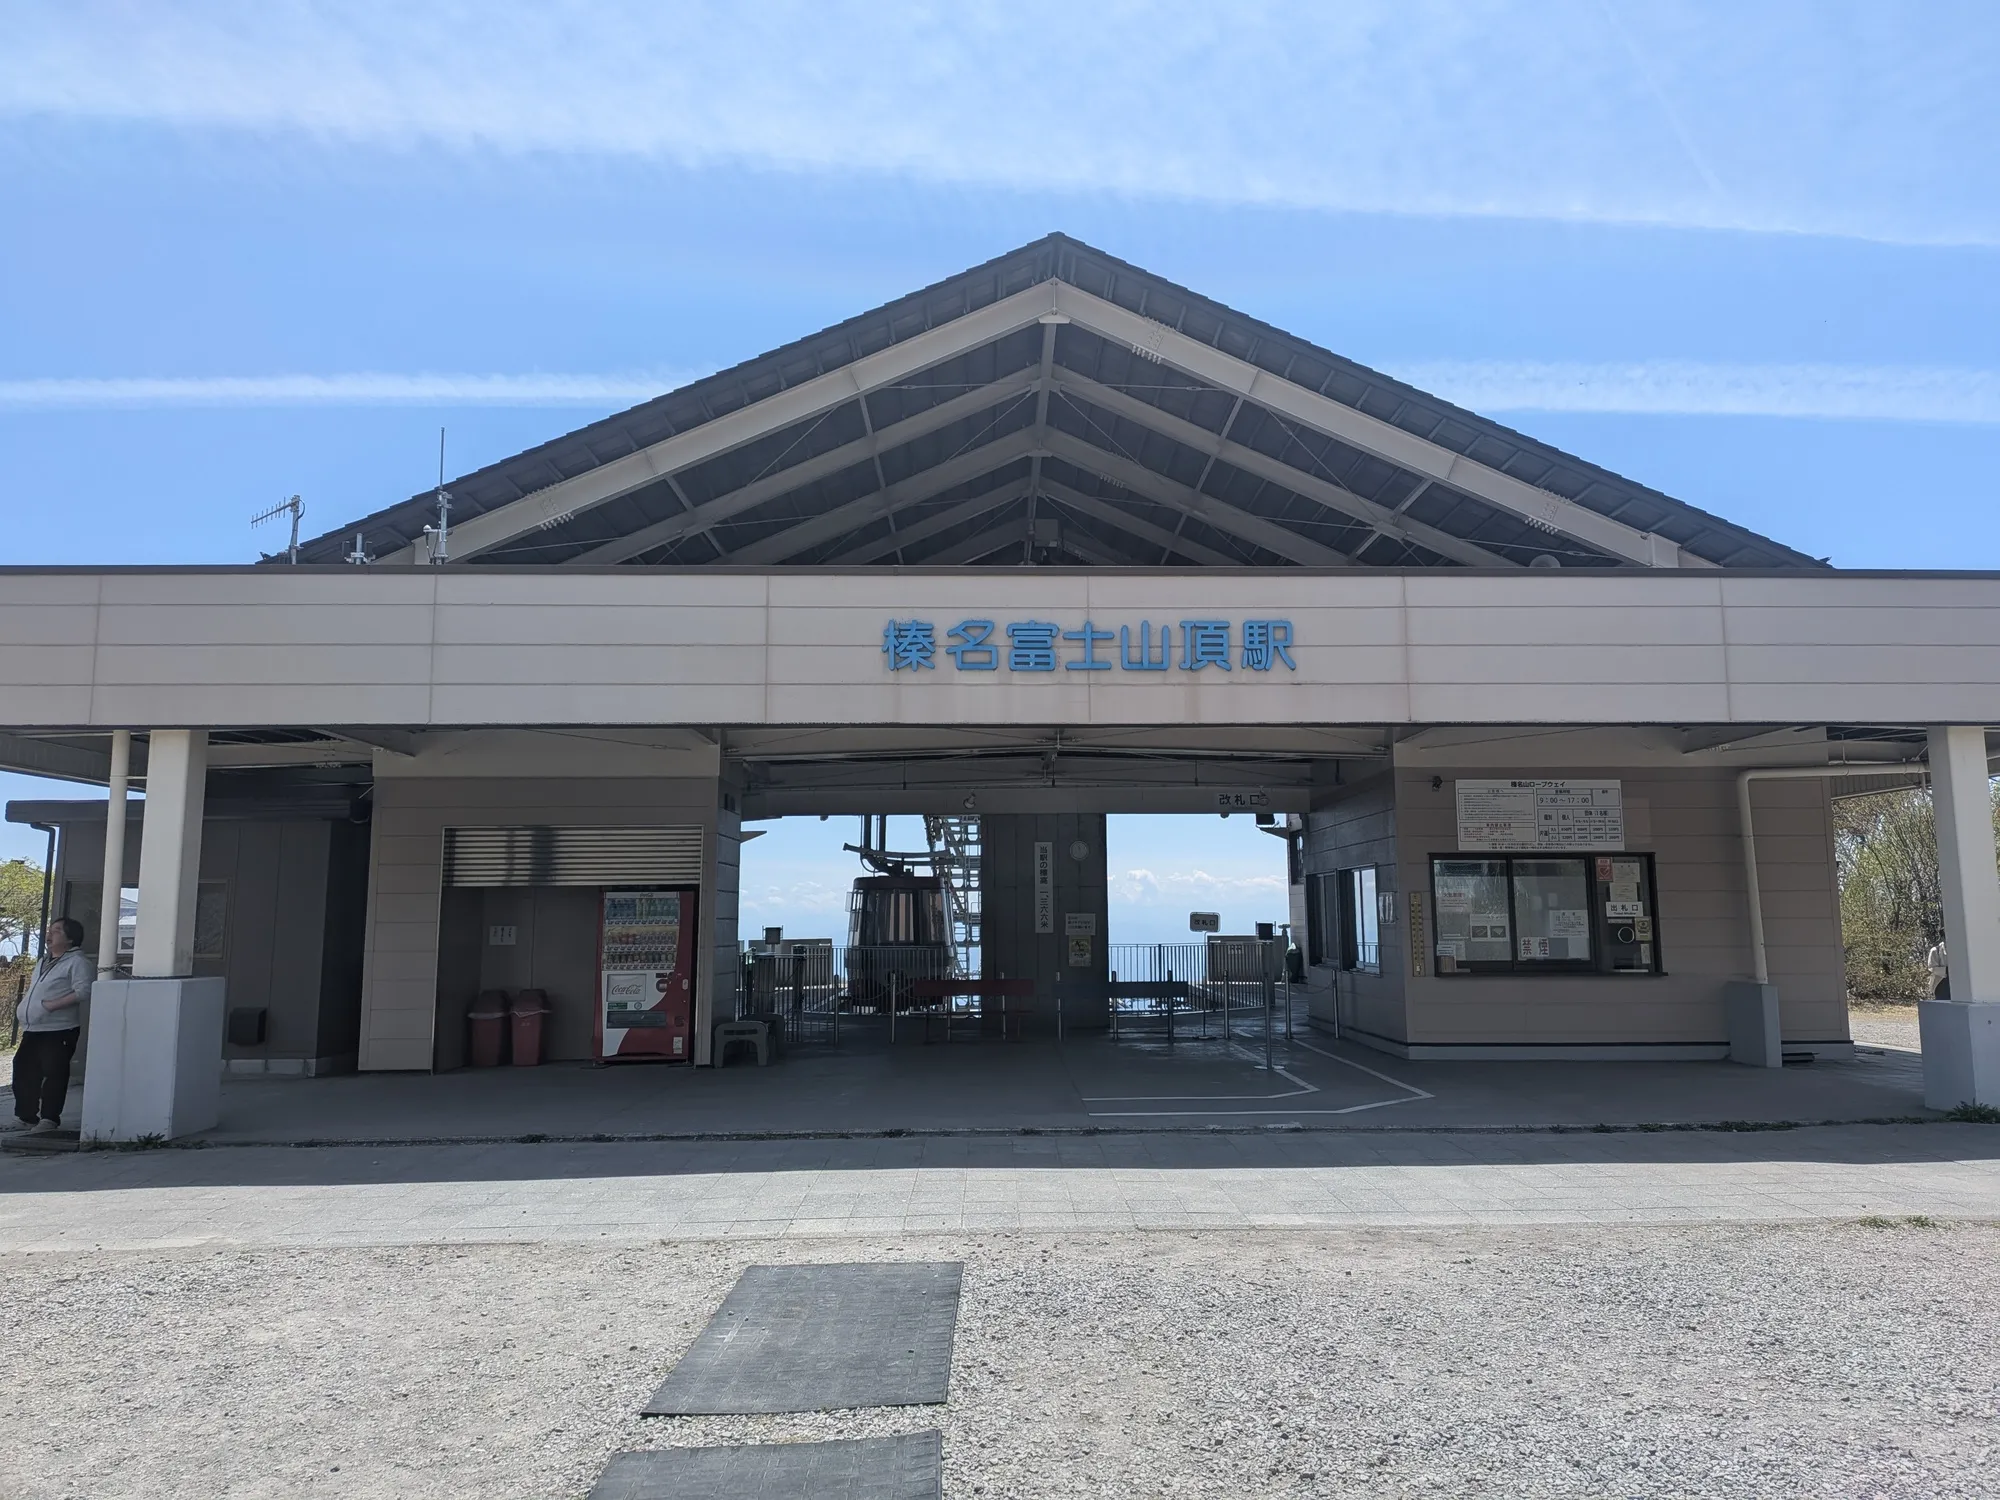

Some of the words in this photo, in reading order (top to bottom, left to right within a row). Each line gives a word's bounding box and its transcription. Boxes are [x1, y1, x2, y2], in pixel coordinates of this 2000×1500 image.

[882, 618, 1297, 672] 榛名富士山頂駅
[1218, 794, 1260, 805] 改札口
[1521, 938, 1549, 956] 禁煙
